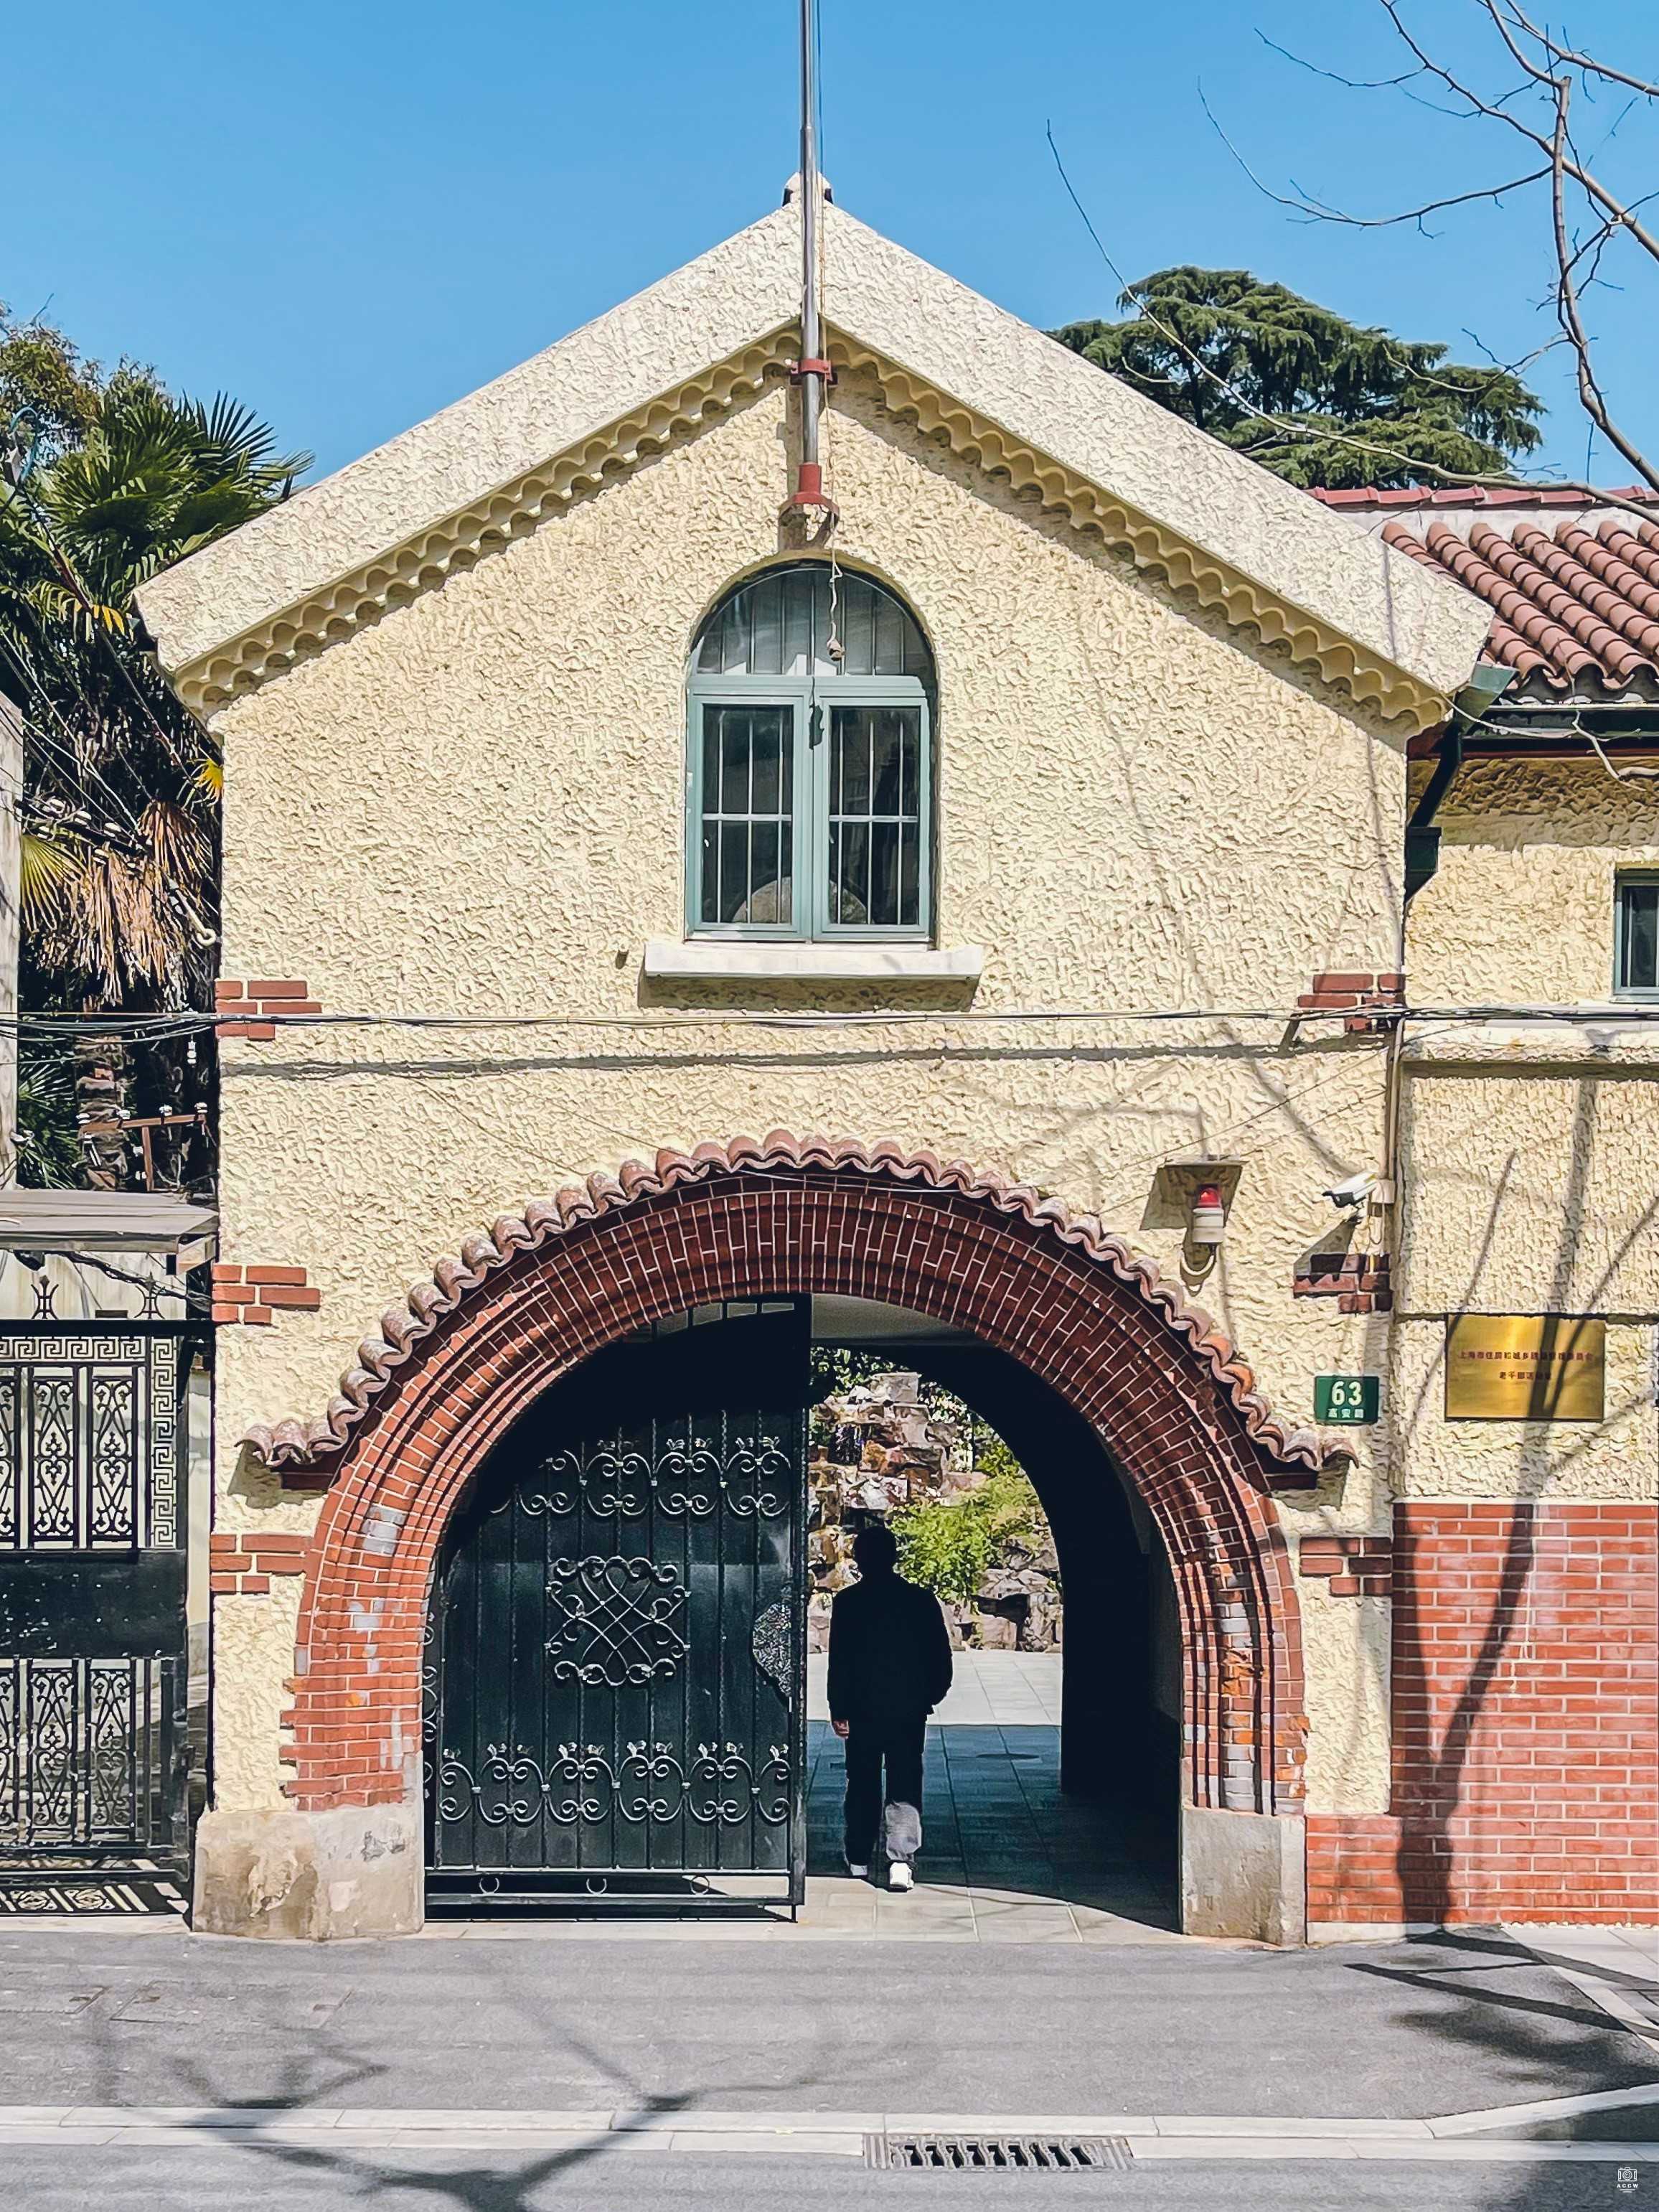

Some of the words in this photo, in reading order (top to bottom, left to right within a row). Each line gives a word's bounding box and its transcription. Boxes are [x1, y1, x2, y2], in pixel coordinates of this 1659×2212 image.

[1499, 1371, 1551, 1380] 老干部活
[1332, 1380, 1362, 1406] 63
